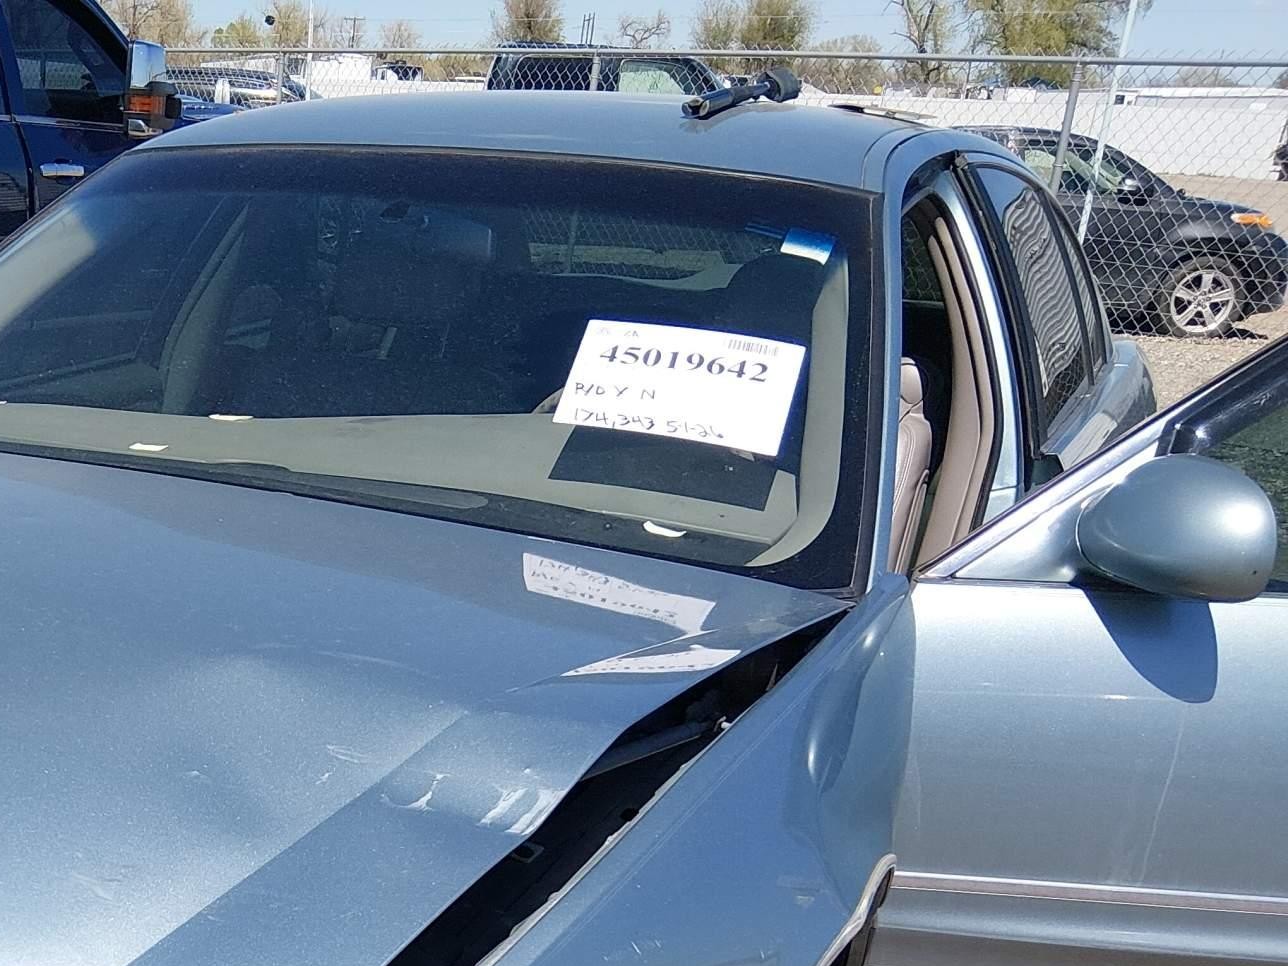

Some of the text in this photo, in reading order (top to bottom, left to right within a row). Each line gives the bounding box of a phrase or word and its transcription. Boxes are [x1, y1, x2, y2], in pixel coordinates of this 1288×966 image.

[599, 344, 769, 382] 45019642
[614, 385, 629, 397] Y
[640, 388, 656, 400] N
